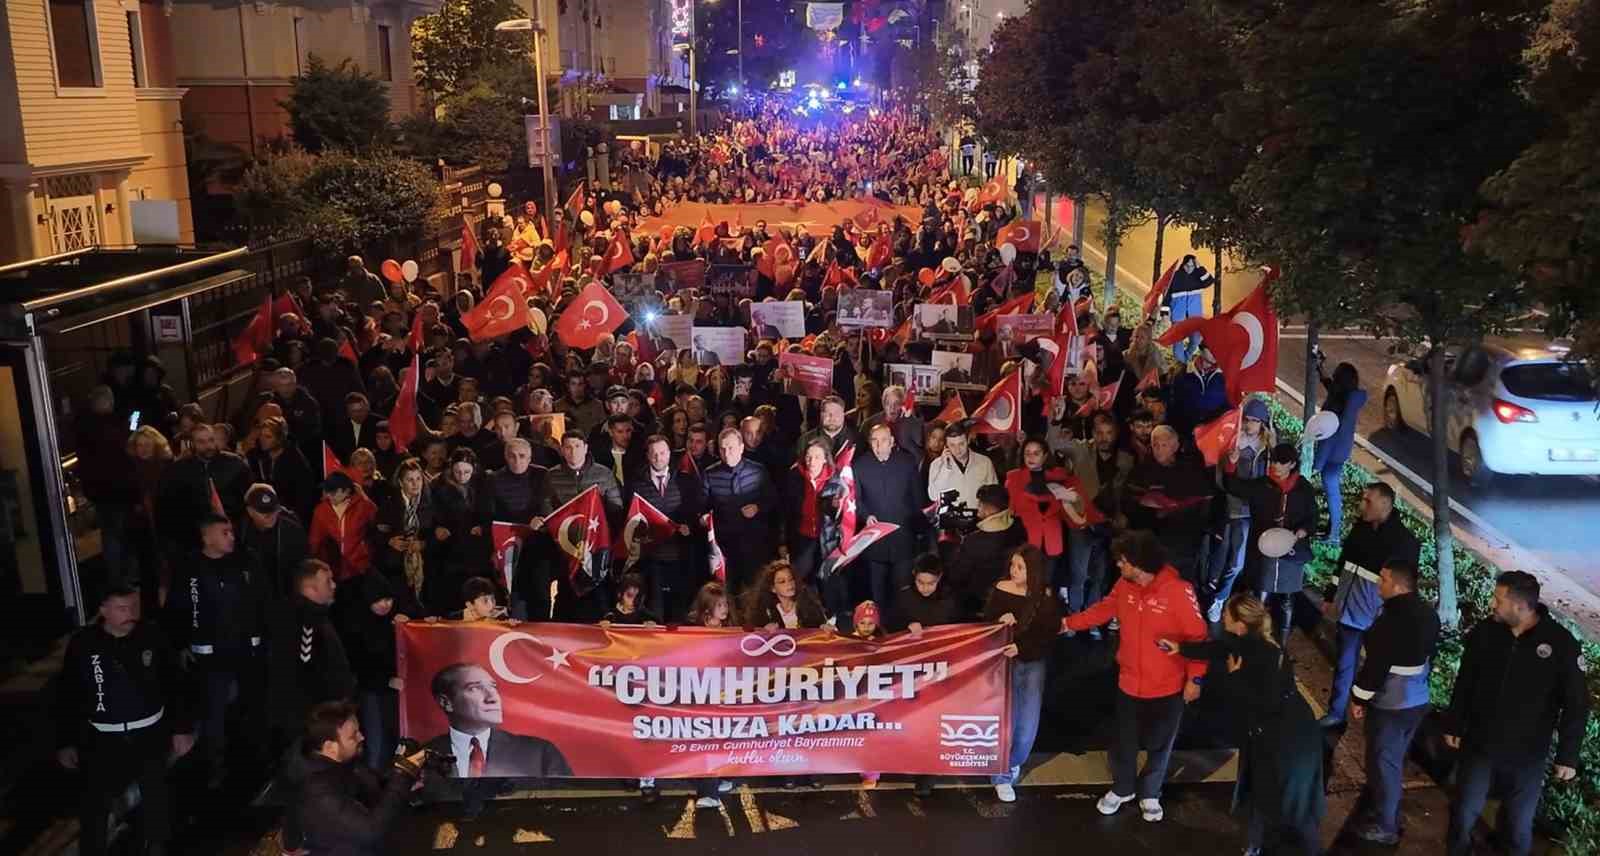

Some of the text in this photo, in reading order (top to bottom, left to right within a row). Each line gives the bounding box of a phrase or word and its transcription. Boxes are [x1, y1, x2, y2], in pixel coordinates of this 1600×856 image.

[91, 654, 106, 712] ZABITA
[632, 712, 902, 739] SONSUZA KADAR...
[670, 736, 865, 753] 29 Ekim Cumhuriyet Bayramımız
[727, 750, 763, 764] kutlu
